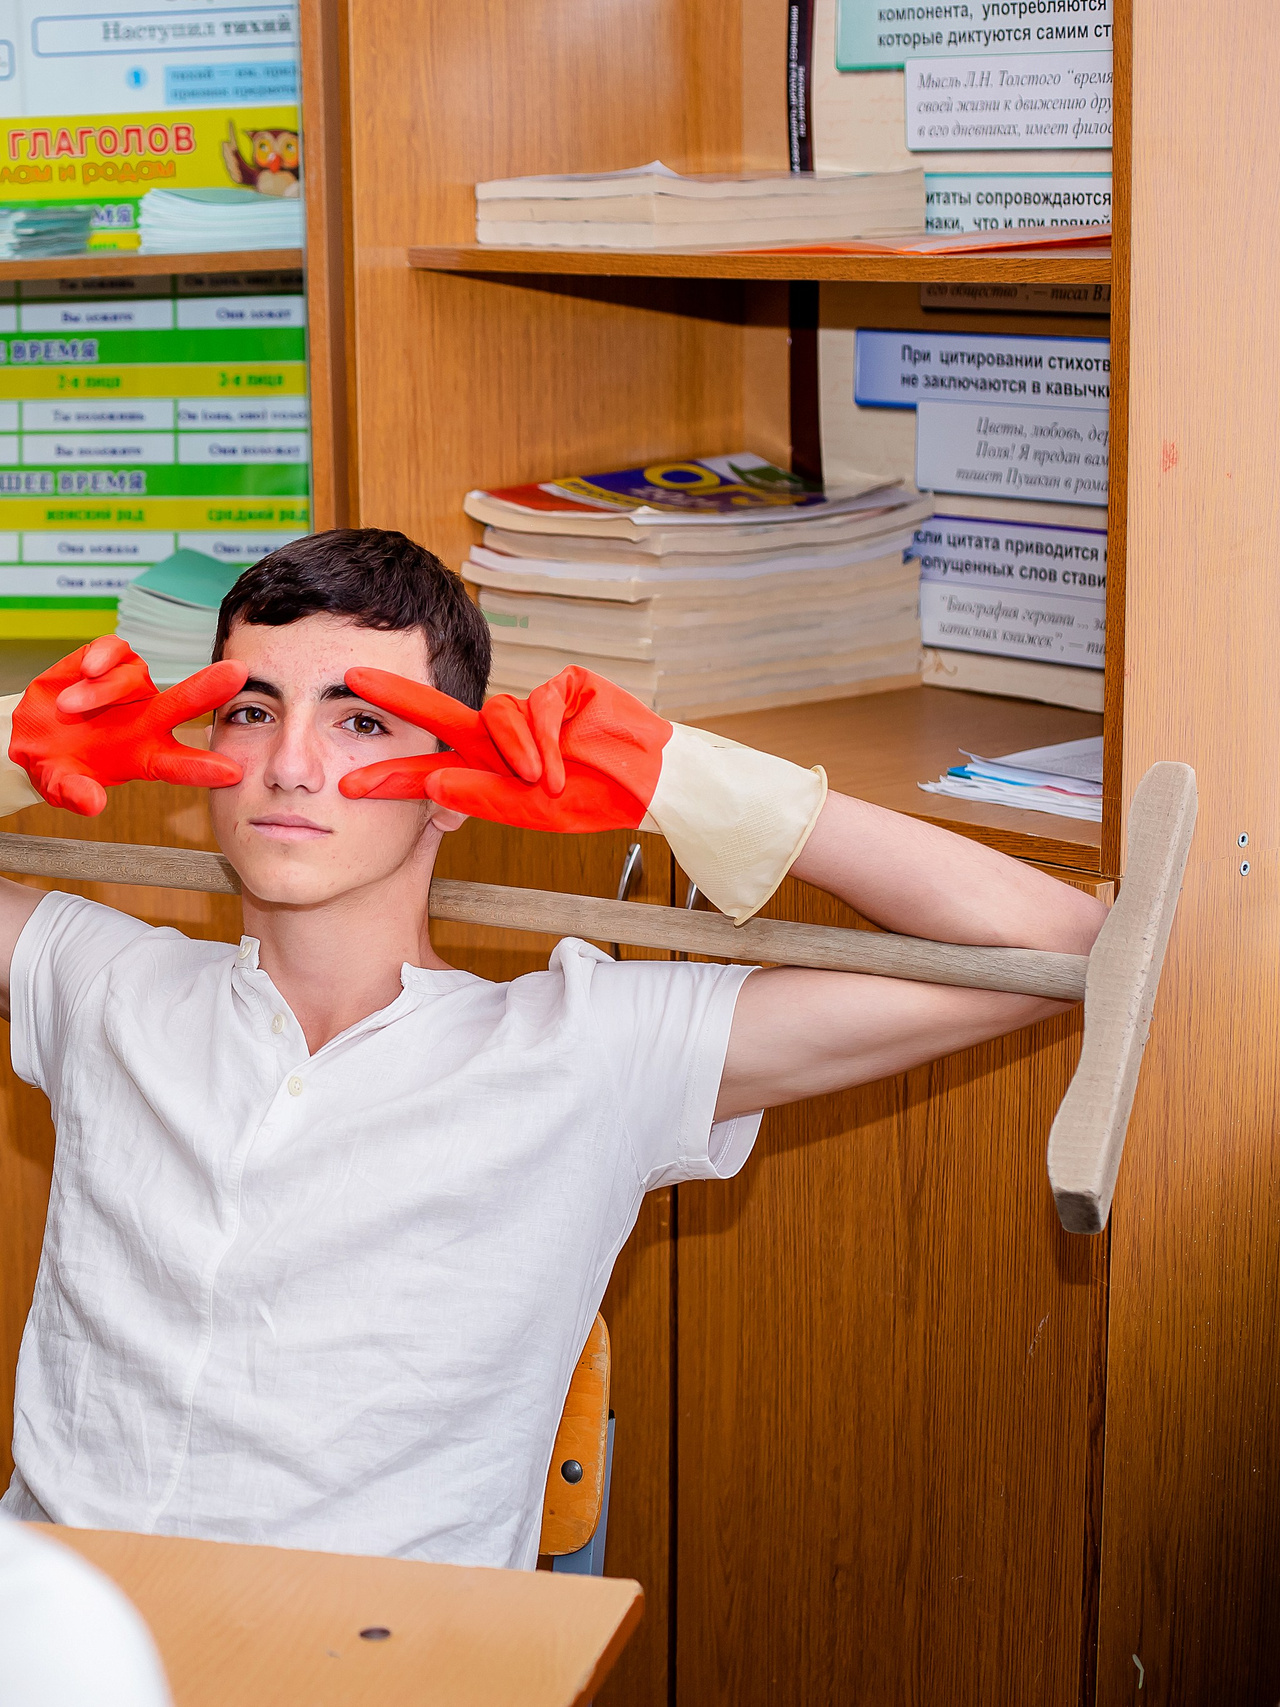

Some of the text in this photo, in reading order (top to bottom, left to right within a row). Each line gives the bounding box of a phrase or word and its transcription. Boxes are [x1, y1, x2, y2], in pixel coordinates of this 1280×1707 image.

[878, 0, 1107, 21] компонента, употребляются
[101, 14, 292, 44] Наступил тихий
[878, 24, 1113, 49] которые диктуются самим ст
[917, 72, 961, 88] Мысль
[998, 70, 1061, 87] Толстого
[917, 97, 953, 113] своей
[957, 99, 1000, 113] жизни
[1004, 100, 1011, 112] к
[1015, 93, 1087, 112] движению
[951, 120, 1021, 137] дневниках,
[1025, 122, 1069, 136] имеет
[9, 124, 196, 160] ГЛАГОЛОВ
[976, 191, 1111, 209] сопровождаются
[973, 217, 999, 231] что
[1003, 217, 1013, 229] и
[11, 339, 98, 362] ВРЕМЯ
[901, 344, 931, 367] При
[939, 350, 1043, 369] цитировании
[901, 373, 919, 388] не
[923, 376, 1026, 393] заключаются
[1032, 381, 1041, 394] в
[1031, 421, 1083, 442] любовь,
[1018, 443, 1030, 460] Я
[1032, 446, 1081, 466] предан
[58, 471, 146, 494] ВРЕМЯ
[1006, 466, 1060, 490] Пушкин
[947, 534, 1000, 551] цитата
[1005, 538, 1099, 562] приводится
[1020, 566, 1057, 583] слов
